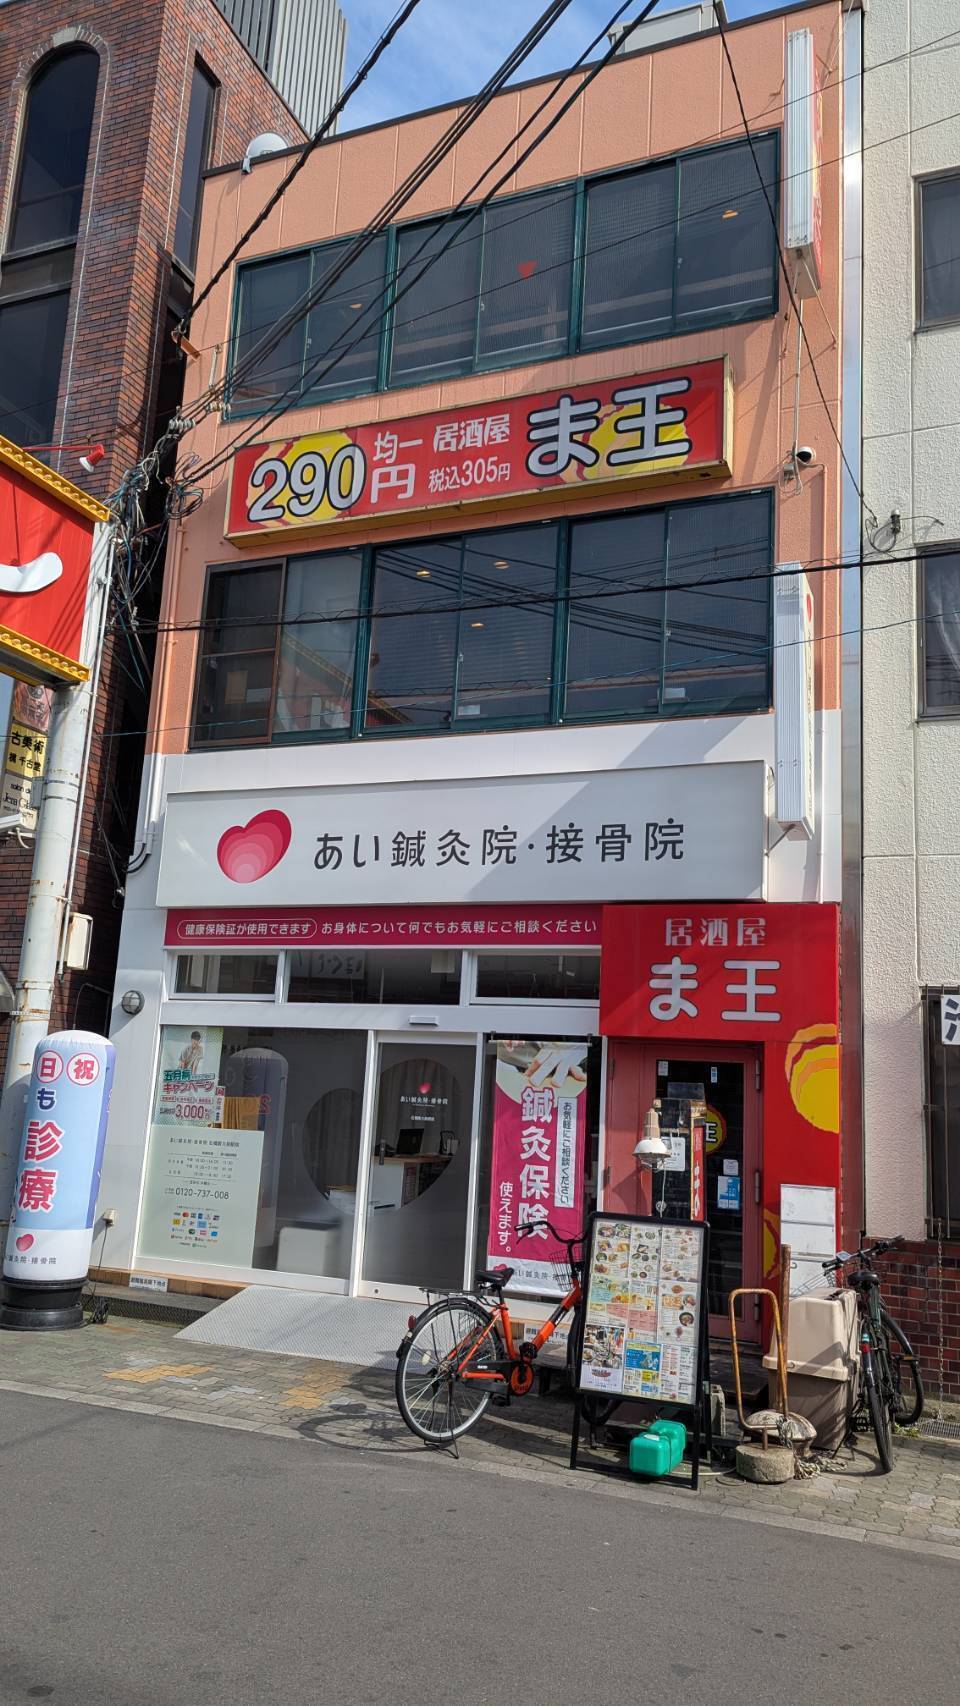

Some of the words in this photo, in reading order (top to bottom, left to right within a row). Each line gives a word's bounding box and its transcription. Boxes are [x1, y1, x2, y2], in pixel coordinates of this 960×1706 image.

[433, 413, 511, 453] 居酒屋
[526, 375, 693, 479] ま王
[373, 431, 423, 464] 均一
[247, 443, 368, 522] 290
[370, 463, 416, 504] 円
[11, 730, 45, 755] 古美術
[313, 817, 685, 870] あい鍼灸院・接骨院
[185, 922, 311, 936] 健康保険証が使用できます
[321, 920, 597, 935] お身体について何でもお気軽にご相談ください
[665, 917, 767, 947] 居酒屋
[648, 955, 781, 1022] ま王
[40, 1057, 57, 1079] 日
[73, 1058, 95, 1080] 祝
[517, 1086, 556, 1240] 鍼灸保険
[175, 1187, 230, 1200] 0120-737-008
